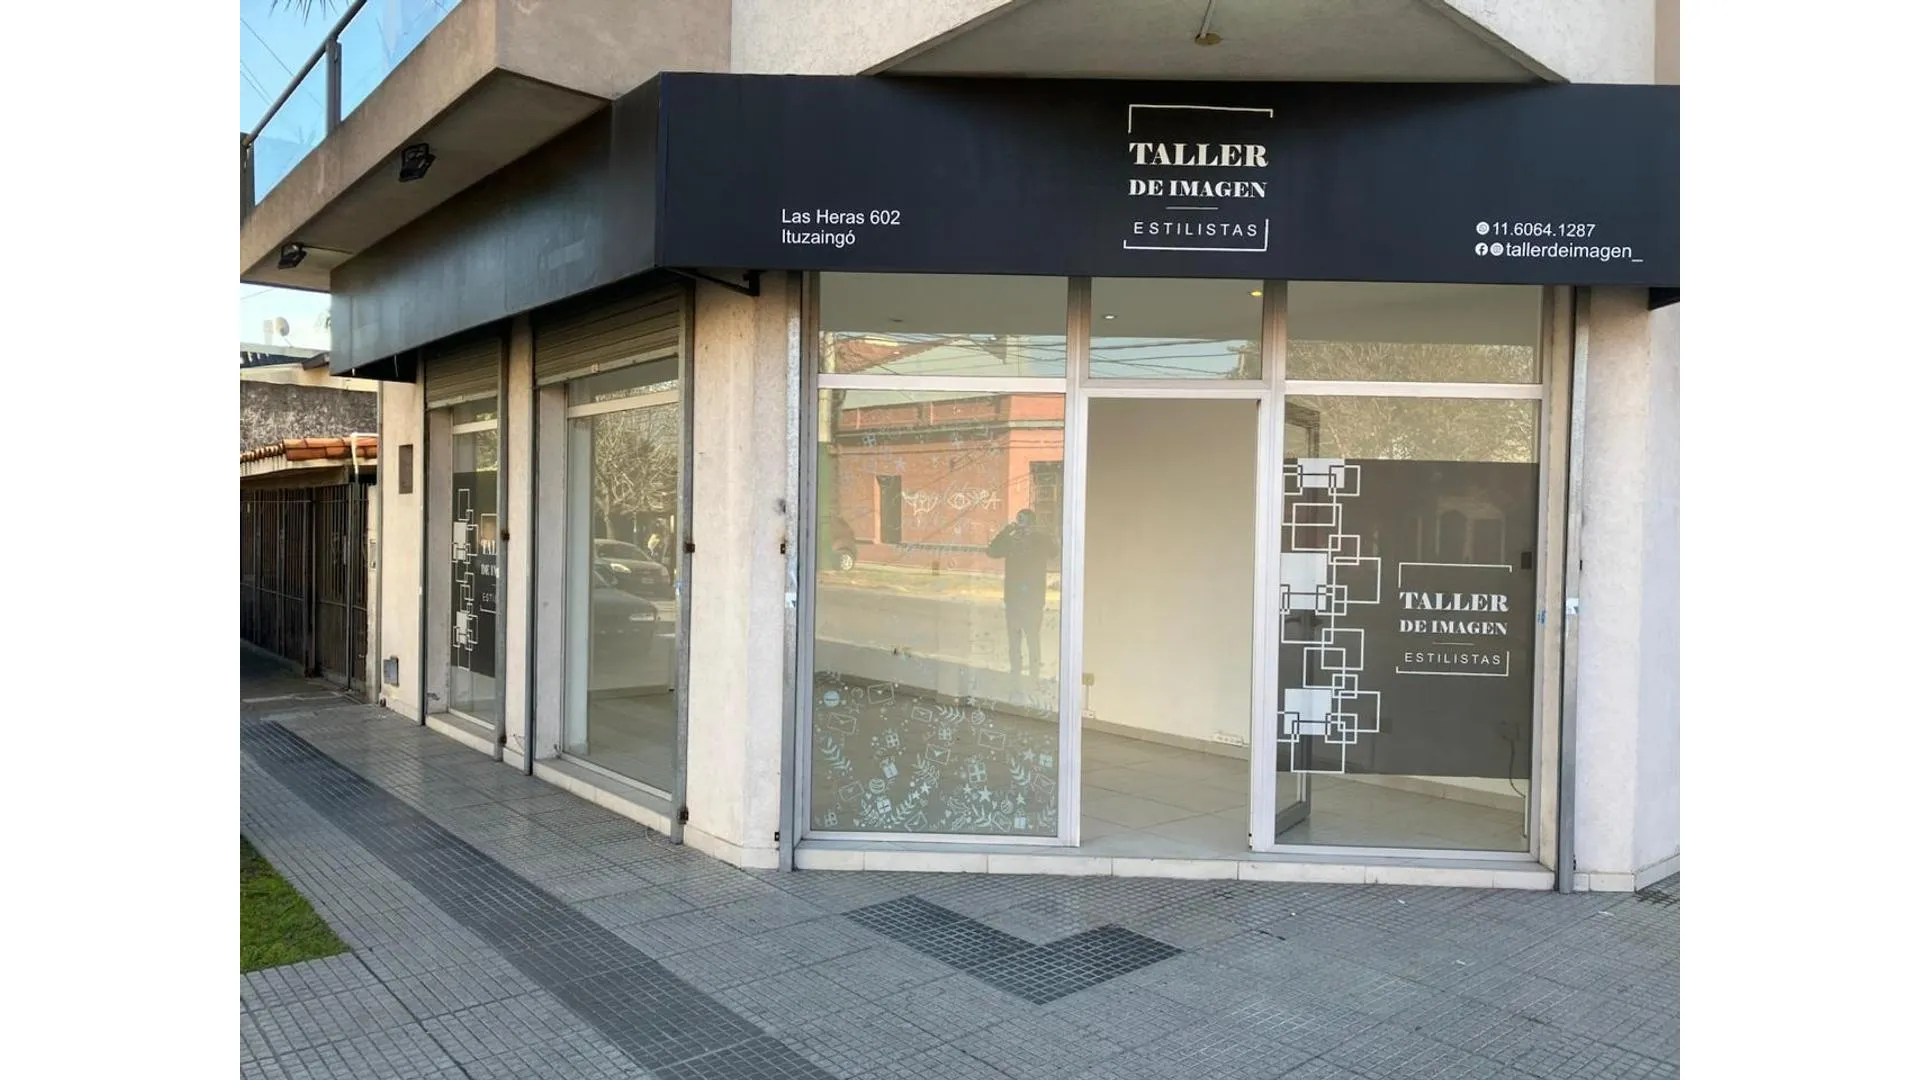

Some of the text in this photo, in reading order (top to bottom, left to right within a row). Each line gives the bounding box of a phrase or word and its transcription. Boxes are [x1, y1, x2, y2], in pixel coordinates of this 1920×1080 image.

[1129, 142, 1269, 167] TALLER
[1129, 179, 1267, 198] DE IMAGEN
[782, 208, 900, 225] Las Heras 602
[1134, 221, 1257, 237] ESTILISTAS
[1492, 222, 1596, 237] 11.6064.1287
[782, 229, 855, 248] Ituzaingó
[1506, 242, 1643, 262] tallerdeimagen_
[1400, 592, 1509, 612] TALLER
[1400, 619, 1508, 635] DE IMAGEN
[1405, 652, 1501, 665] ESTILISTAS
